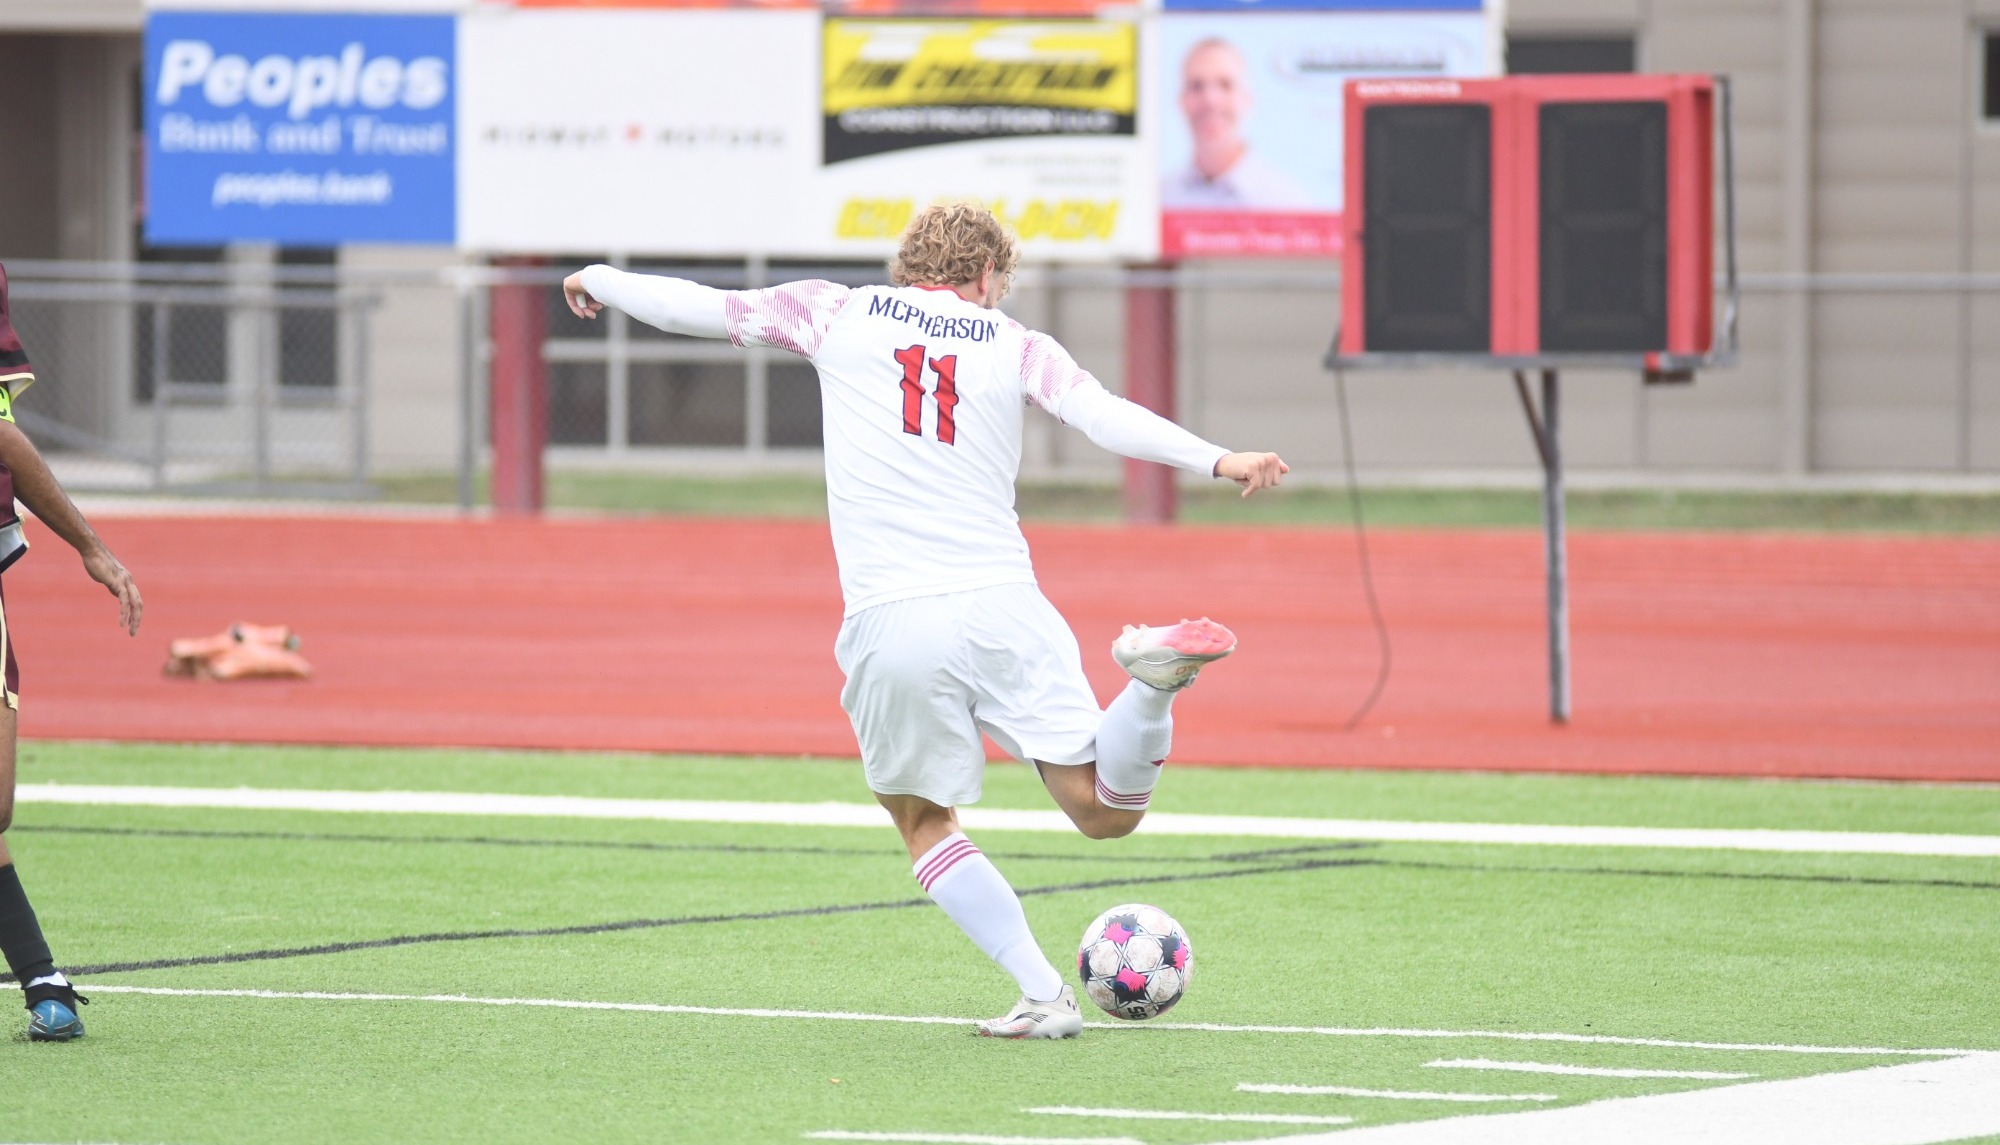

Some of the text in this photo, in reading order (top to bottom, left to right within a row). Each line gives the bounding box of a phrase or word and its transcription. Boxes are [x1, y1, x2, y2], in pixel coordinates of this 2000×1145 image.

[156, 39, 448, 120] Peoples
[159, 112, 447, 155] Bank and Trust
[212, 169, 393, 209] peoples.bank
[868, 295, 999, 342] MCPHERSON
[894, 344, 959, 446] 11
